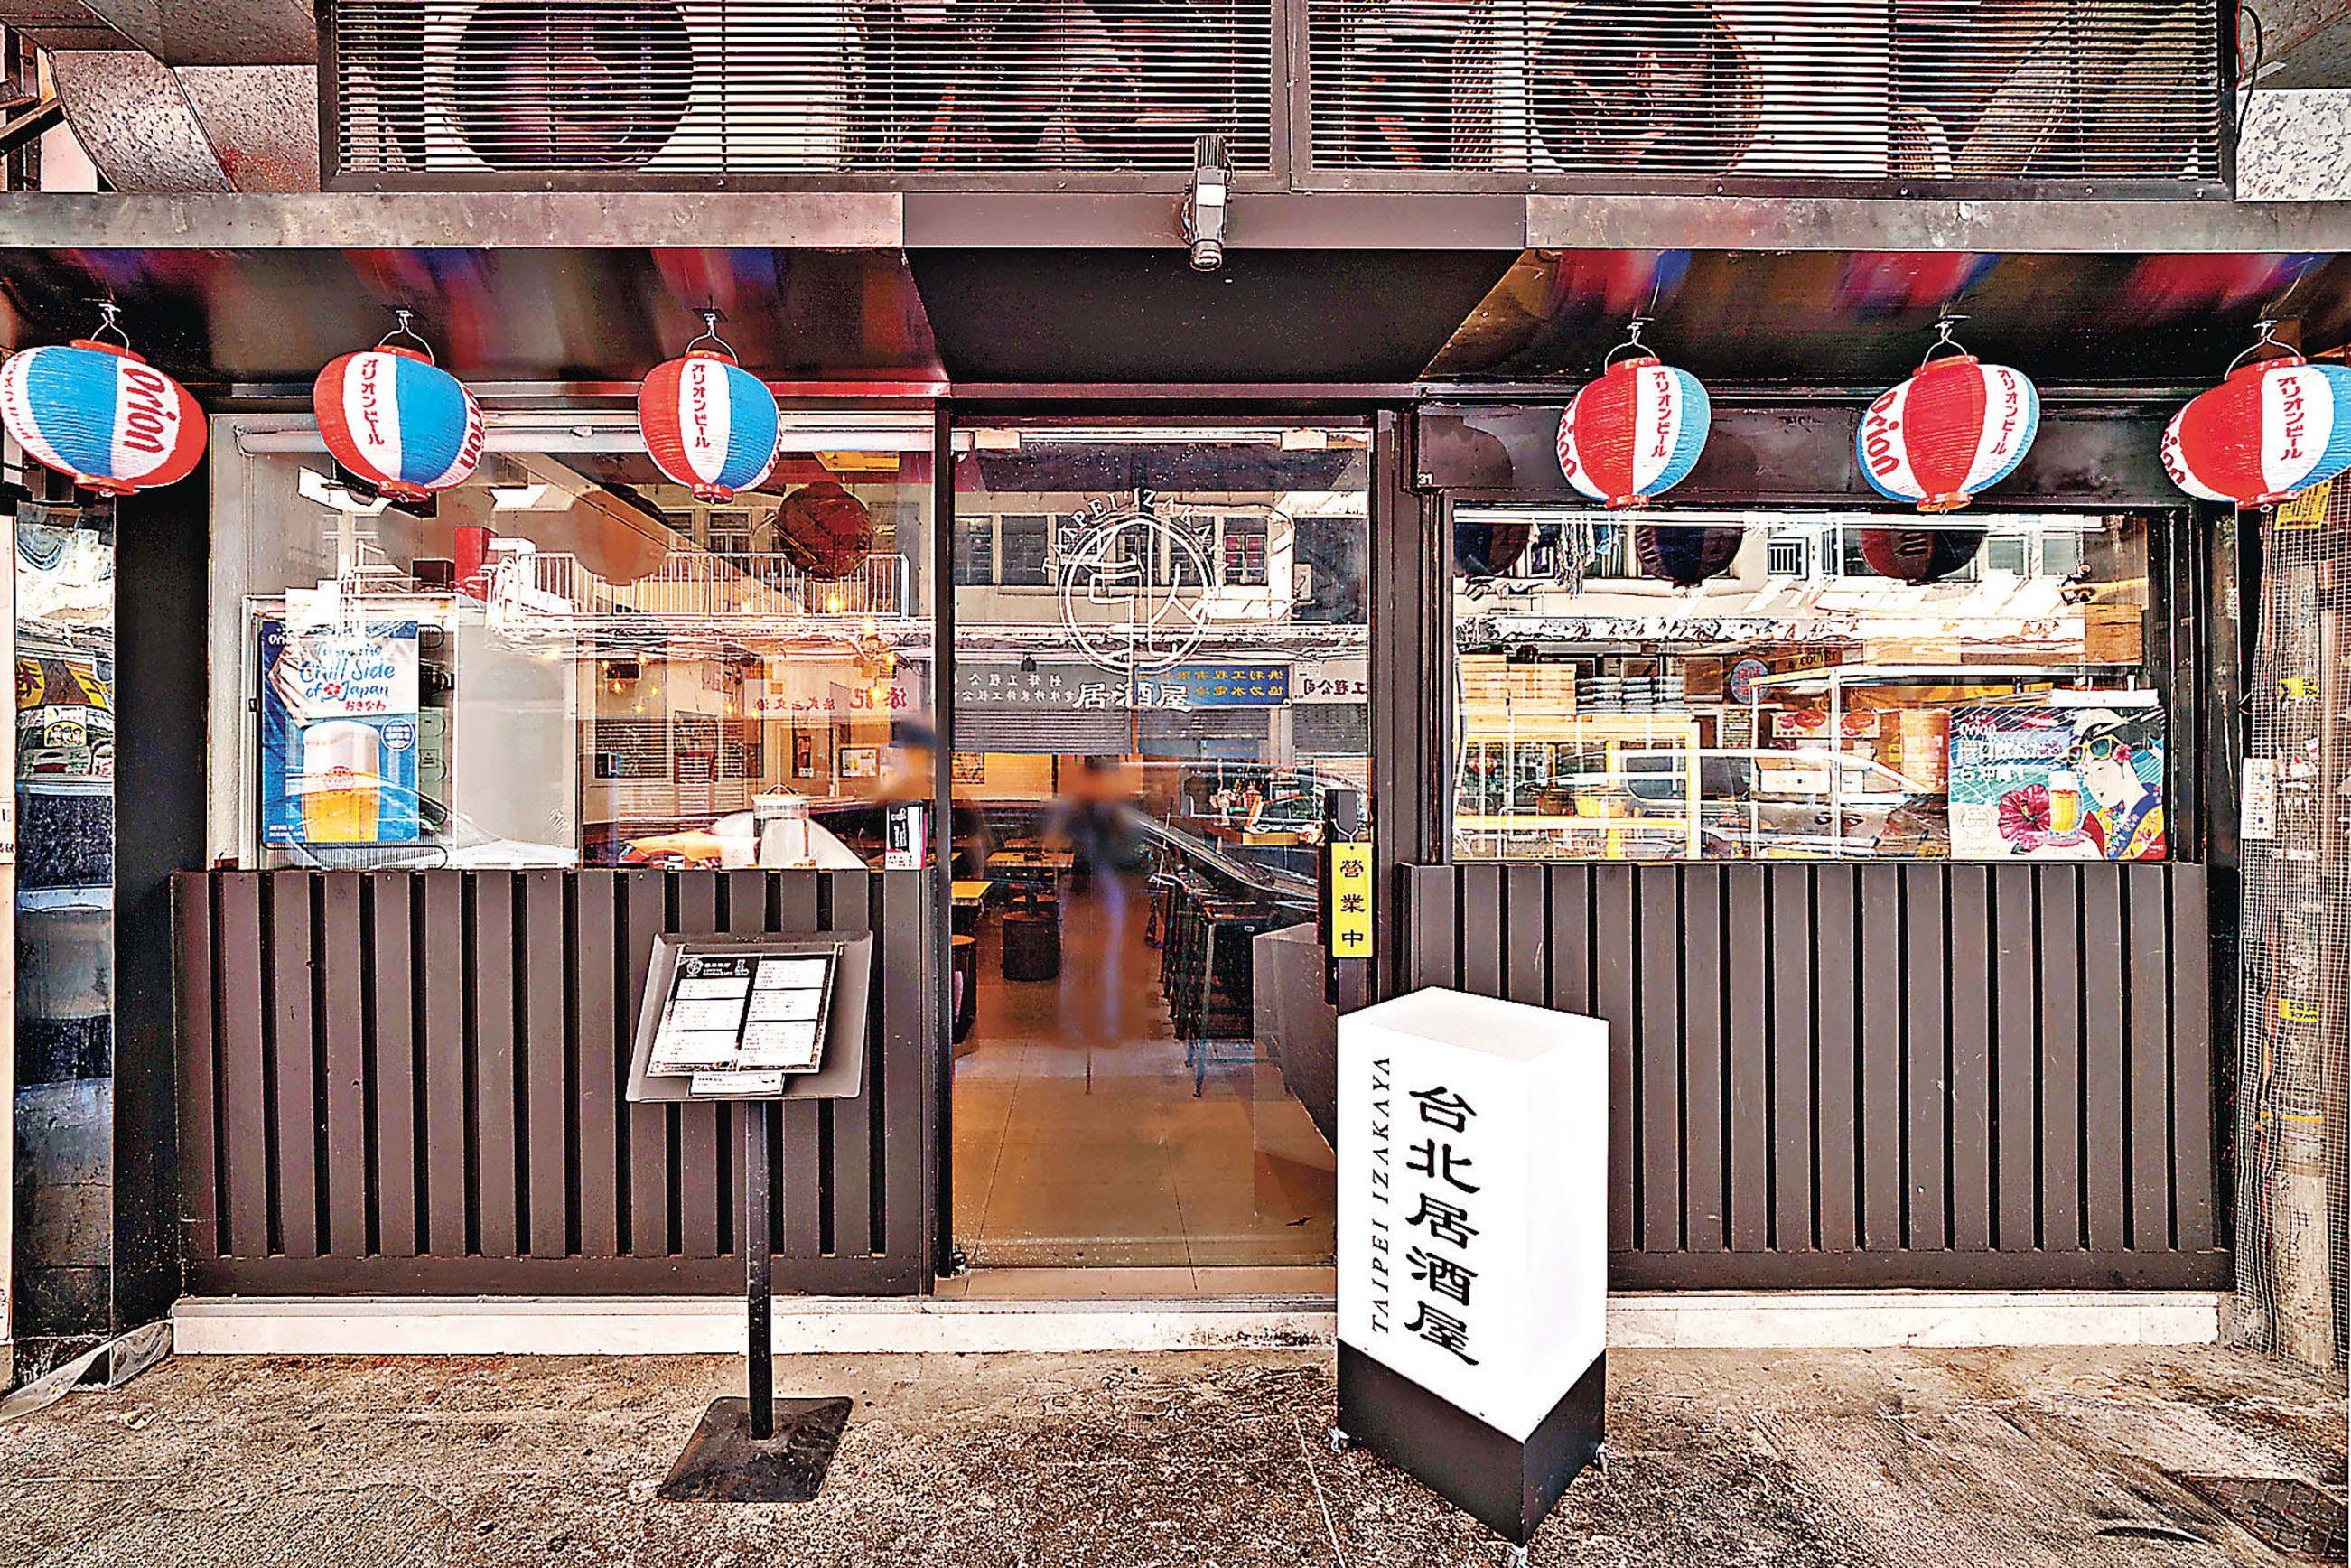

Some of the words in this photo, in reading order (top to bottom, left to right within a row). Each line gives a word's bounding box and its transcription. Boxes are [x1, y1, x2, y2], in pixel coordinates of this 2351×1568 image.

[122, 367, 177, 453] Orion
[361, 359, 385, 445] オリオンビール
[691, 363, 710, 448] オリオンビール
[1651, 371, 1672, 458] オリオンビール
[1864, 390, 1900, 478] Orion
[1990, 369, 2018, 455] オリオンビール
[2277, 376, 2305, 462] オリオンビール
[300, 658, 348, 683] Chill
[351, 658, 396, 681] Side
[305, 682, 322, 698] of
[330, 682, 389, 702] Japan
[345, 700, 387, 712] おきなわ
[1072, 682, 1193, 713] 居酒屋
[1339, 859, 1366, 947] 營業中
[1372, 1057, 1391, 1205] IZAKAYA
[1404, 1086, 1481, 1366] 台北居酒屋
[1372, 1218, 1389, 1335] TAIPEI
